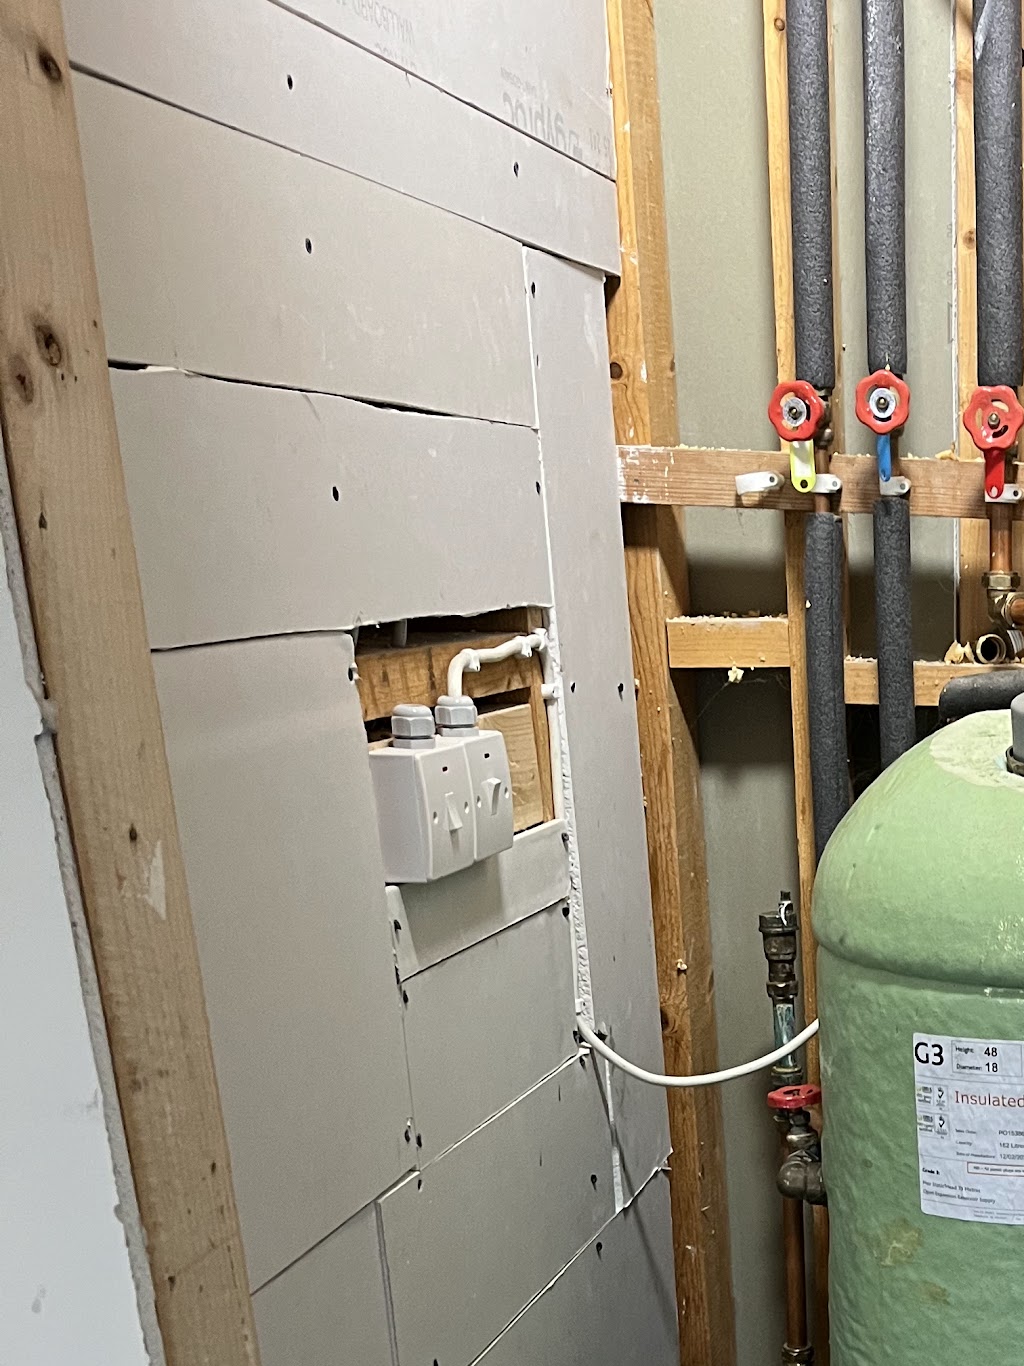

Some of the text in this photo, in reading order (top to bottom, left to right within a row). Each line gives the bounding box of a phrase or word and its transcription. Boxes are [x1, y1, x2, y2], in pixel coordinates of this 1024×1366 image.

[914, 1041, 944, 1066] G3
[984, 1046, 998, 1057] 48
[985, 1062, 998, 1073] 18
